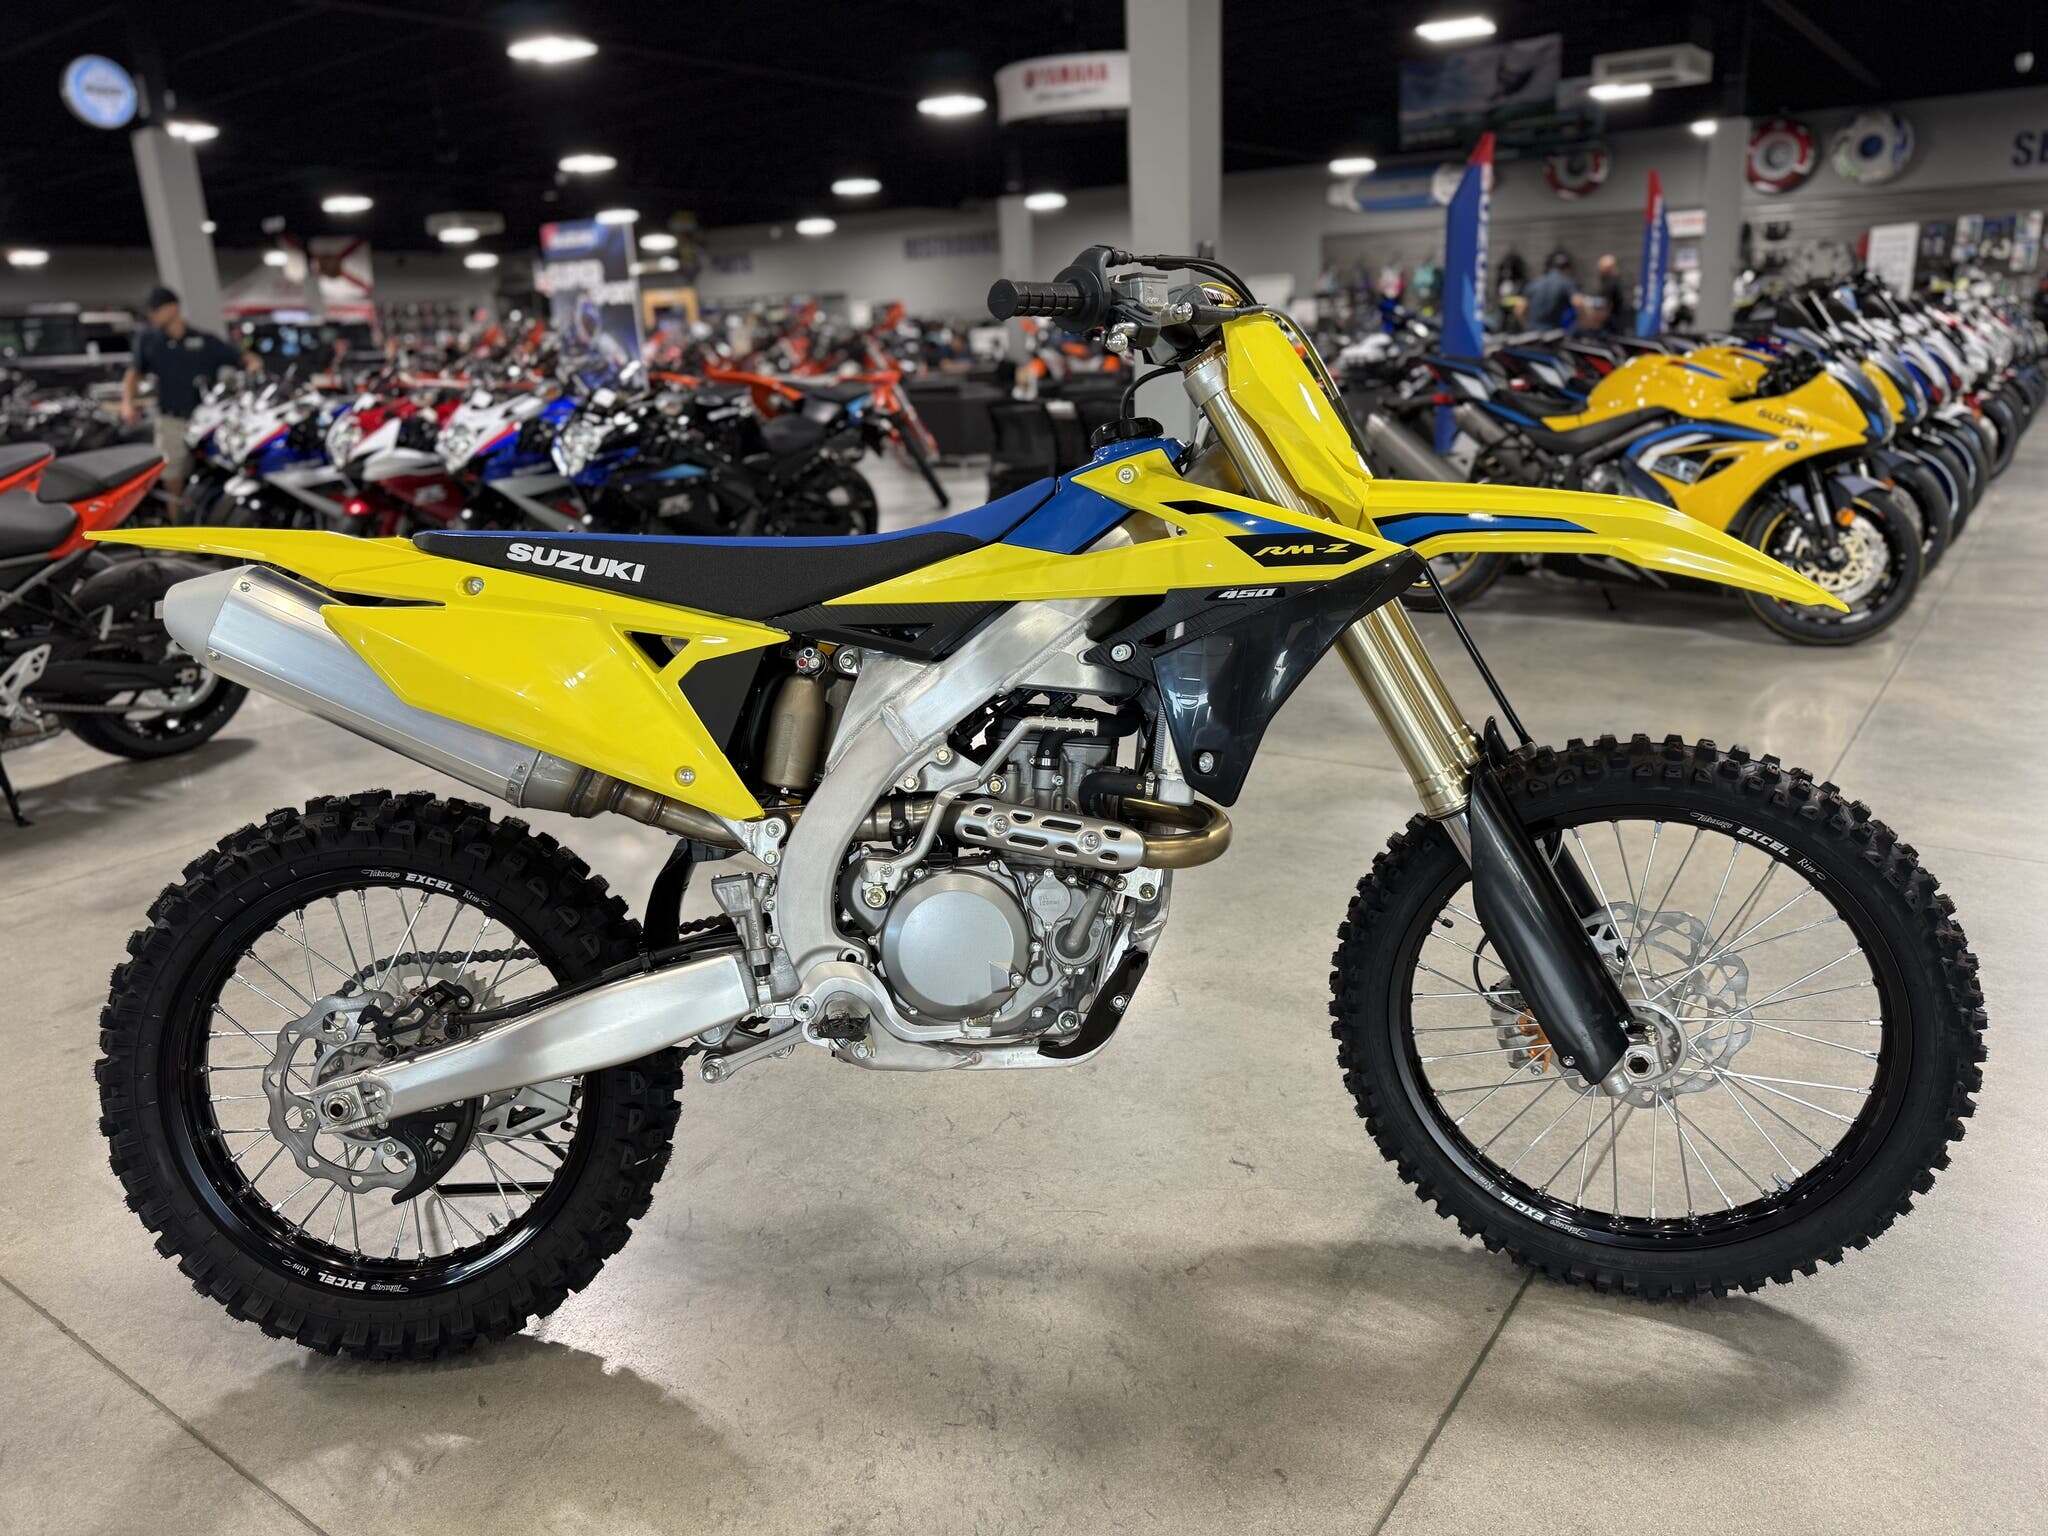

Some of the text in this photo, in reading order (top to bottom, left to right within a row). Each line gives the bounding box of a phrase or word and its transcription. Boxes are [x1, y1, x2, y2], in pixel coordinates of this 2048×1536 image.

[1758, 408, 1814, 434] SUZUKI
[506, 543, 645, 582] SUZUKI
[1253, 543, 1350, 557] RM-Z
[1218, 587, 1278, 599] 450
[1737, 826, 1789, 857] EXCEL
[1798, 858, 1821, 877] Rim
[405, 872, 455, 893] EXCEL
[463, 889, 484, 904] Rim
[1500, 1191, 1547, 1222] EXCEL
[318, 1272, 367, 1291] EXCEL
